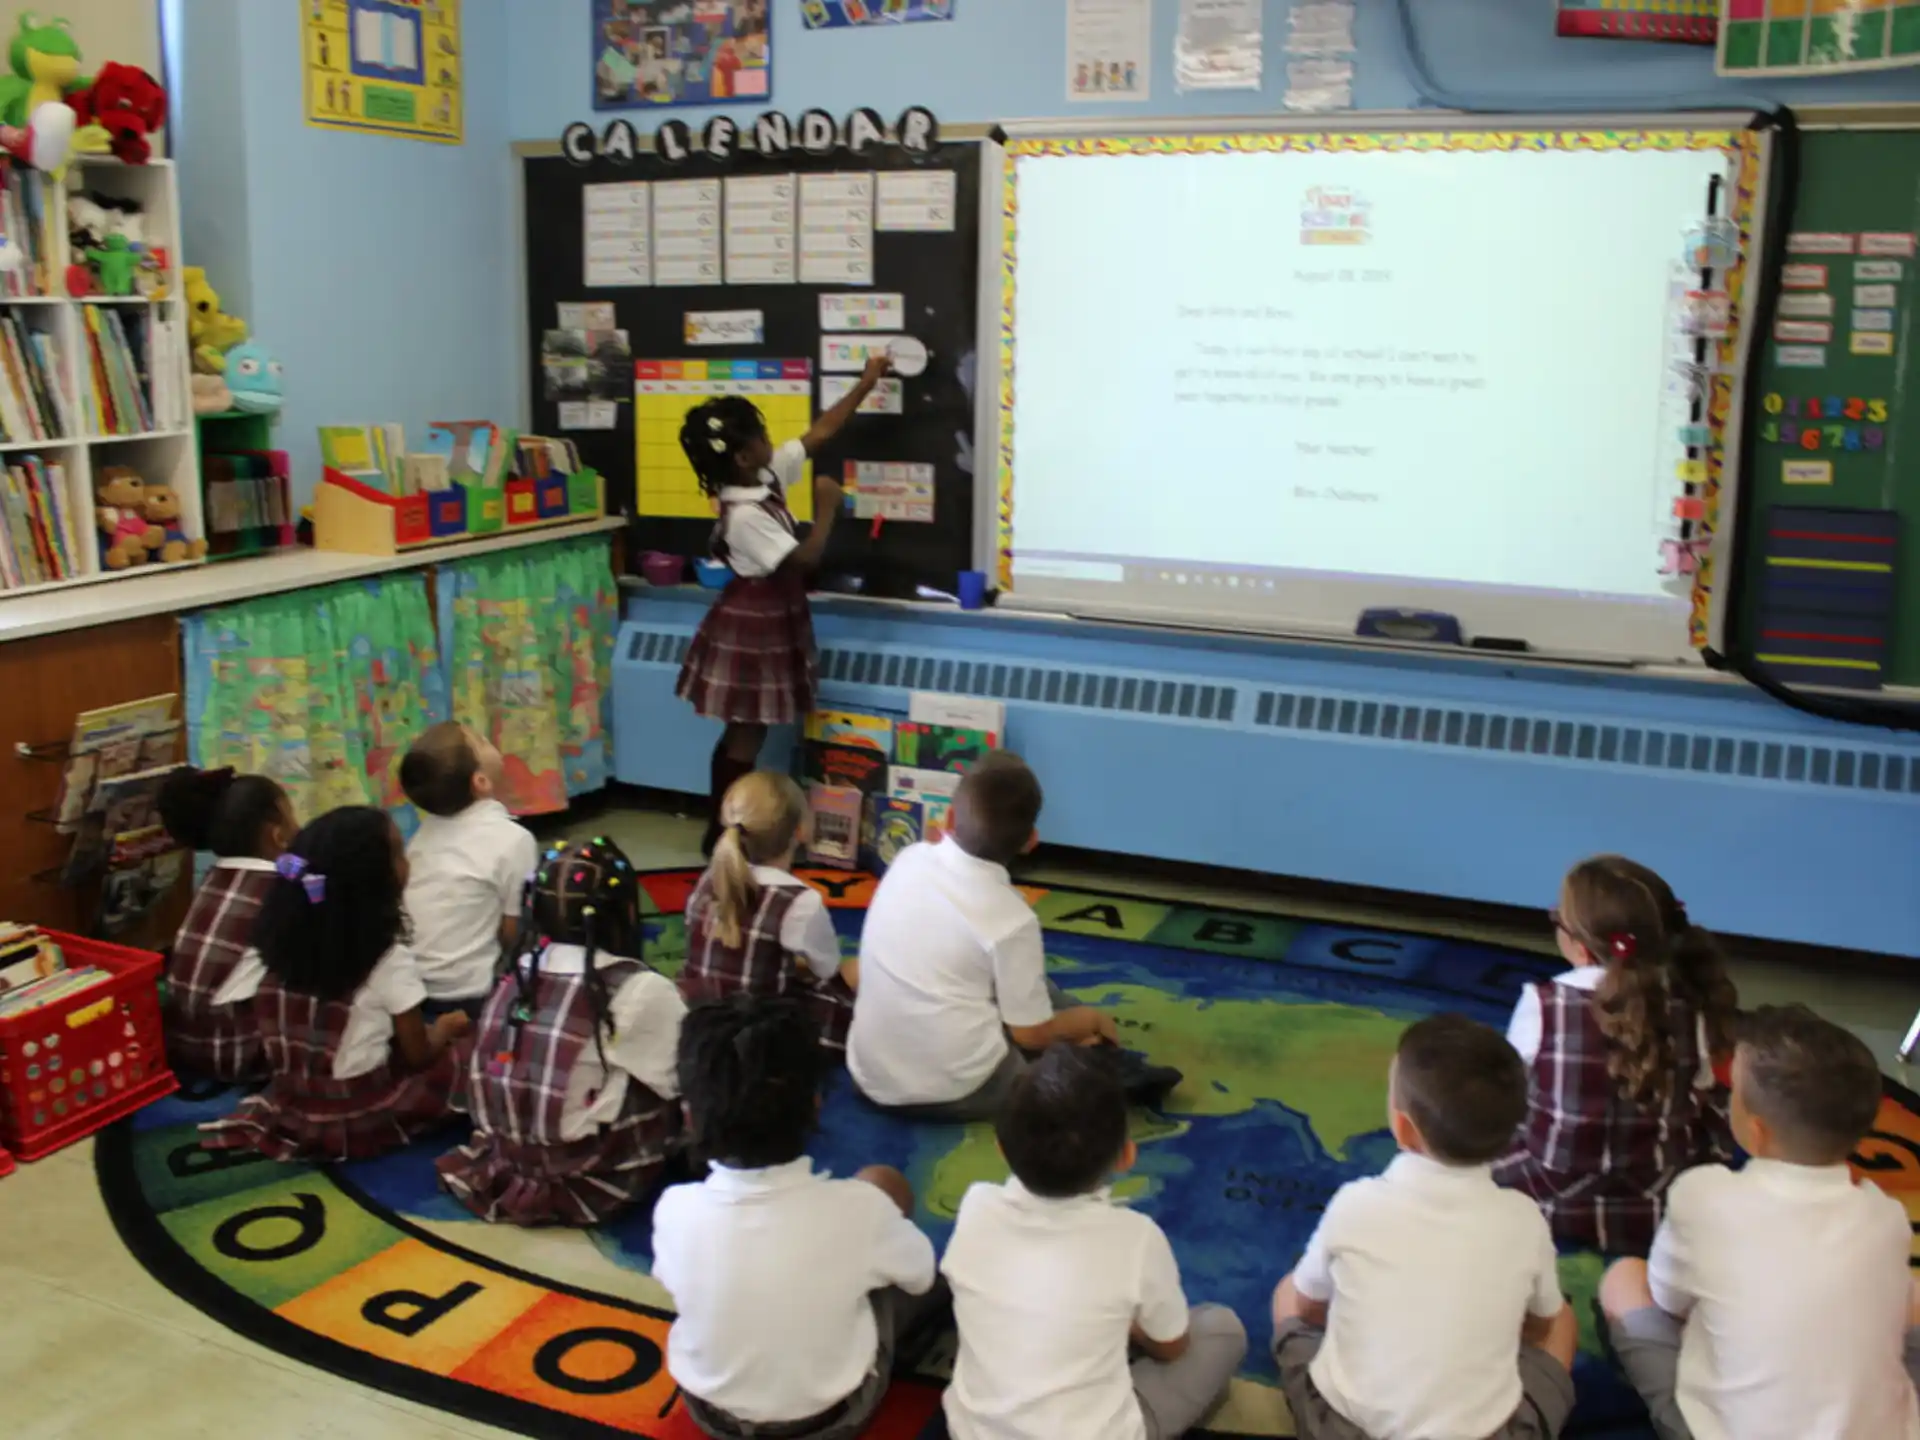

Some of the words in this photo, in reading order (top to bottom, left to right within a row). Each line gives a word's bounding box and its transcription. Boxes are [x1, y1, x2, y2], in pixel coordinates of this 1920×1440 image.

[565, 108, 933, 161] CALENDAR
[807, 876, 865, 898] Y
[1053, 904, 1126, 931] A
[1190, 918, 1259, 945] B
[1330, 938, 1405, 966] C
[211, 1190, 328, 1263] Q
[360, 1279, 486, 1338] P
[531, 1325, 664, 1395] O
